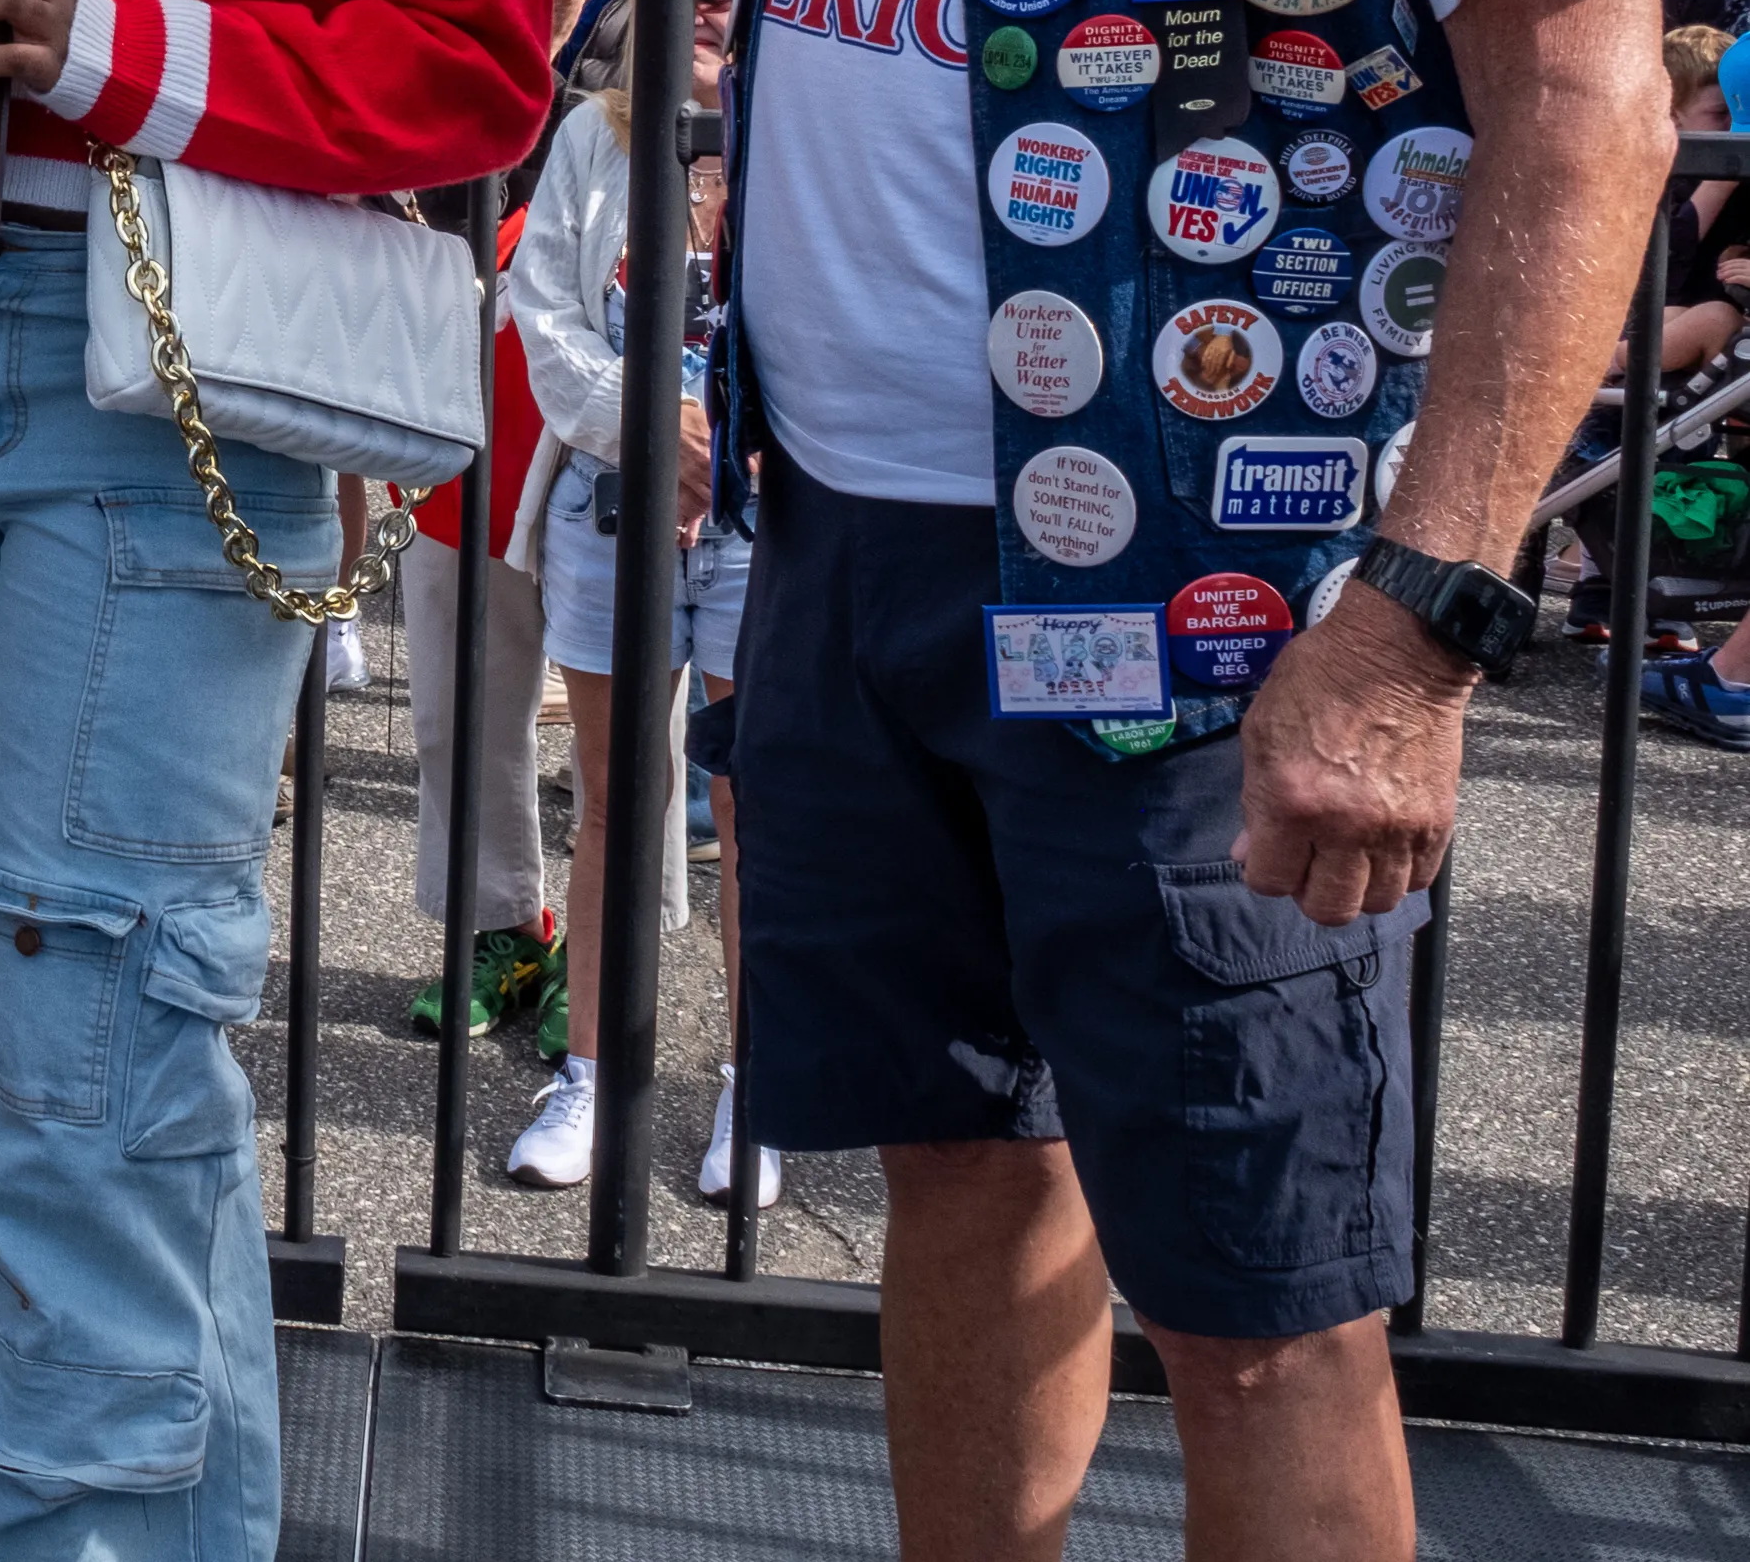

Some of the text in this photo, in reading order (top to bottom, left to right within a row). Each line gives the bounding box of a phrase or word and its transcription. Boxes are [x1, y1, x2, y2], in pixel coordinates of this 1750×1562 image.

[1165, 9, 1221, 26] Mourn
[1085, 24, 1143, 35] DIGNITY
[1168, 30, 1223, 48] for the
[1084, 34, 1144, 45] JUSTICE
[1269, 40, 1327, 56] DIGNITY
[1070, 50, 1152, 63] WHATEVER
[1174, 51, 1221, 69] Dead
[1268, 51, 1326, 66] JUSTICE
[1079, 62, 1143, 75] IT TAKES
[1254, 60, 1334, 82] WHATEVER
[1089, 75, 1132, 84] TWU-234
[1262, 73, 1325, 92] IT TAKES
[1271, 86, 1314, 99] TWU-234
[1018, 137, 1090, 162] WORKERS'
[1279, 133, 1355, 166] PHILADELPHIA
[1014, 153, 1082, 182] RIGHTS
[1292, 164, 1346, 178] WORKERS
[1288, 176, 1357, 203] JOINT BOARD
[1302, 174, 1342, 186] UNITED
[1011, 181, 1078, 210] HUMAN
[1170, 170, 1264, 216] UNION
[1008, 199, 1074, 229] RIGHTS
[1168, 204, 1219, 243] YES
[1291, 237, 1332, 250] TWU
[1275, 254, 1338, 273] SECTION
[1371, 242, 1417, 286] LIVING
[1272, 280, 1332, 297] OFFICER
[1004, 302, 1073, 322] Workers
[1174, 304, 1259, 336] SAFETY
[1016, 322, 1062, 340] Unite
[1372, 307, 1423, 347] FAMILY
[1031, 341, 1047, 354] for
[1320, 324, 1372, 356] BE WISE
[1016, 351, 1067, 370] Better
[1016, 369, 1070, 391] Wages
[1162, 372, 1276, 419] TEAMWORK
[1195, 387, 1241, 400] THROUGH
[1302, 374, 1364, 417] ORGANIZE
[1057, 457, 1097, 475] If YOU
[1230, 458, 1348, 492] transit
[1028, 471, 1121, 500] don't Stand for
[1033, 491, 1114, 520] SOMETHING,
[1227, 494, 1344, 515] matters
[1030, 509, 1115, 537] You'll FALL for
[1039, 530, 1099, 555] Anything!
[1194, 590, 1258, 603] UNITED
[1212, 603, 1240, 615] WE
[1035, 614, 1103, 634] Happy
[1186, 615, 1267, 629] BARGAIN
[997, 632, 1157, 662] LABOR
[1195, 638, 1267, 651] DIVIDED
[1216, 652, 1245, 663] WE
[1212, 663, 1251, 676] BEG
[1112, 730, 1144, 741] LABOR
[1148, 725, 1166, 736] DAY
